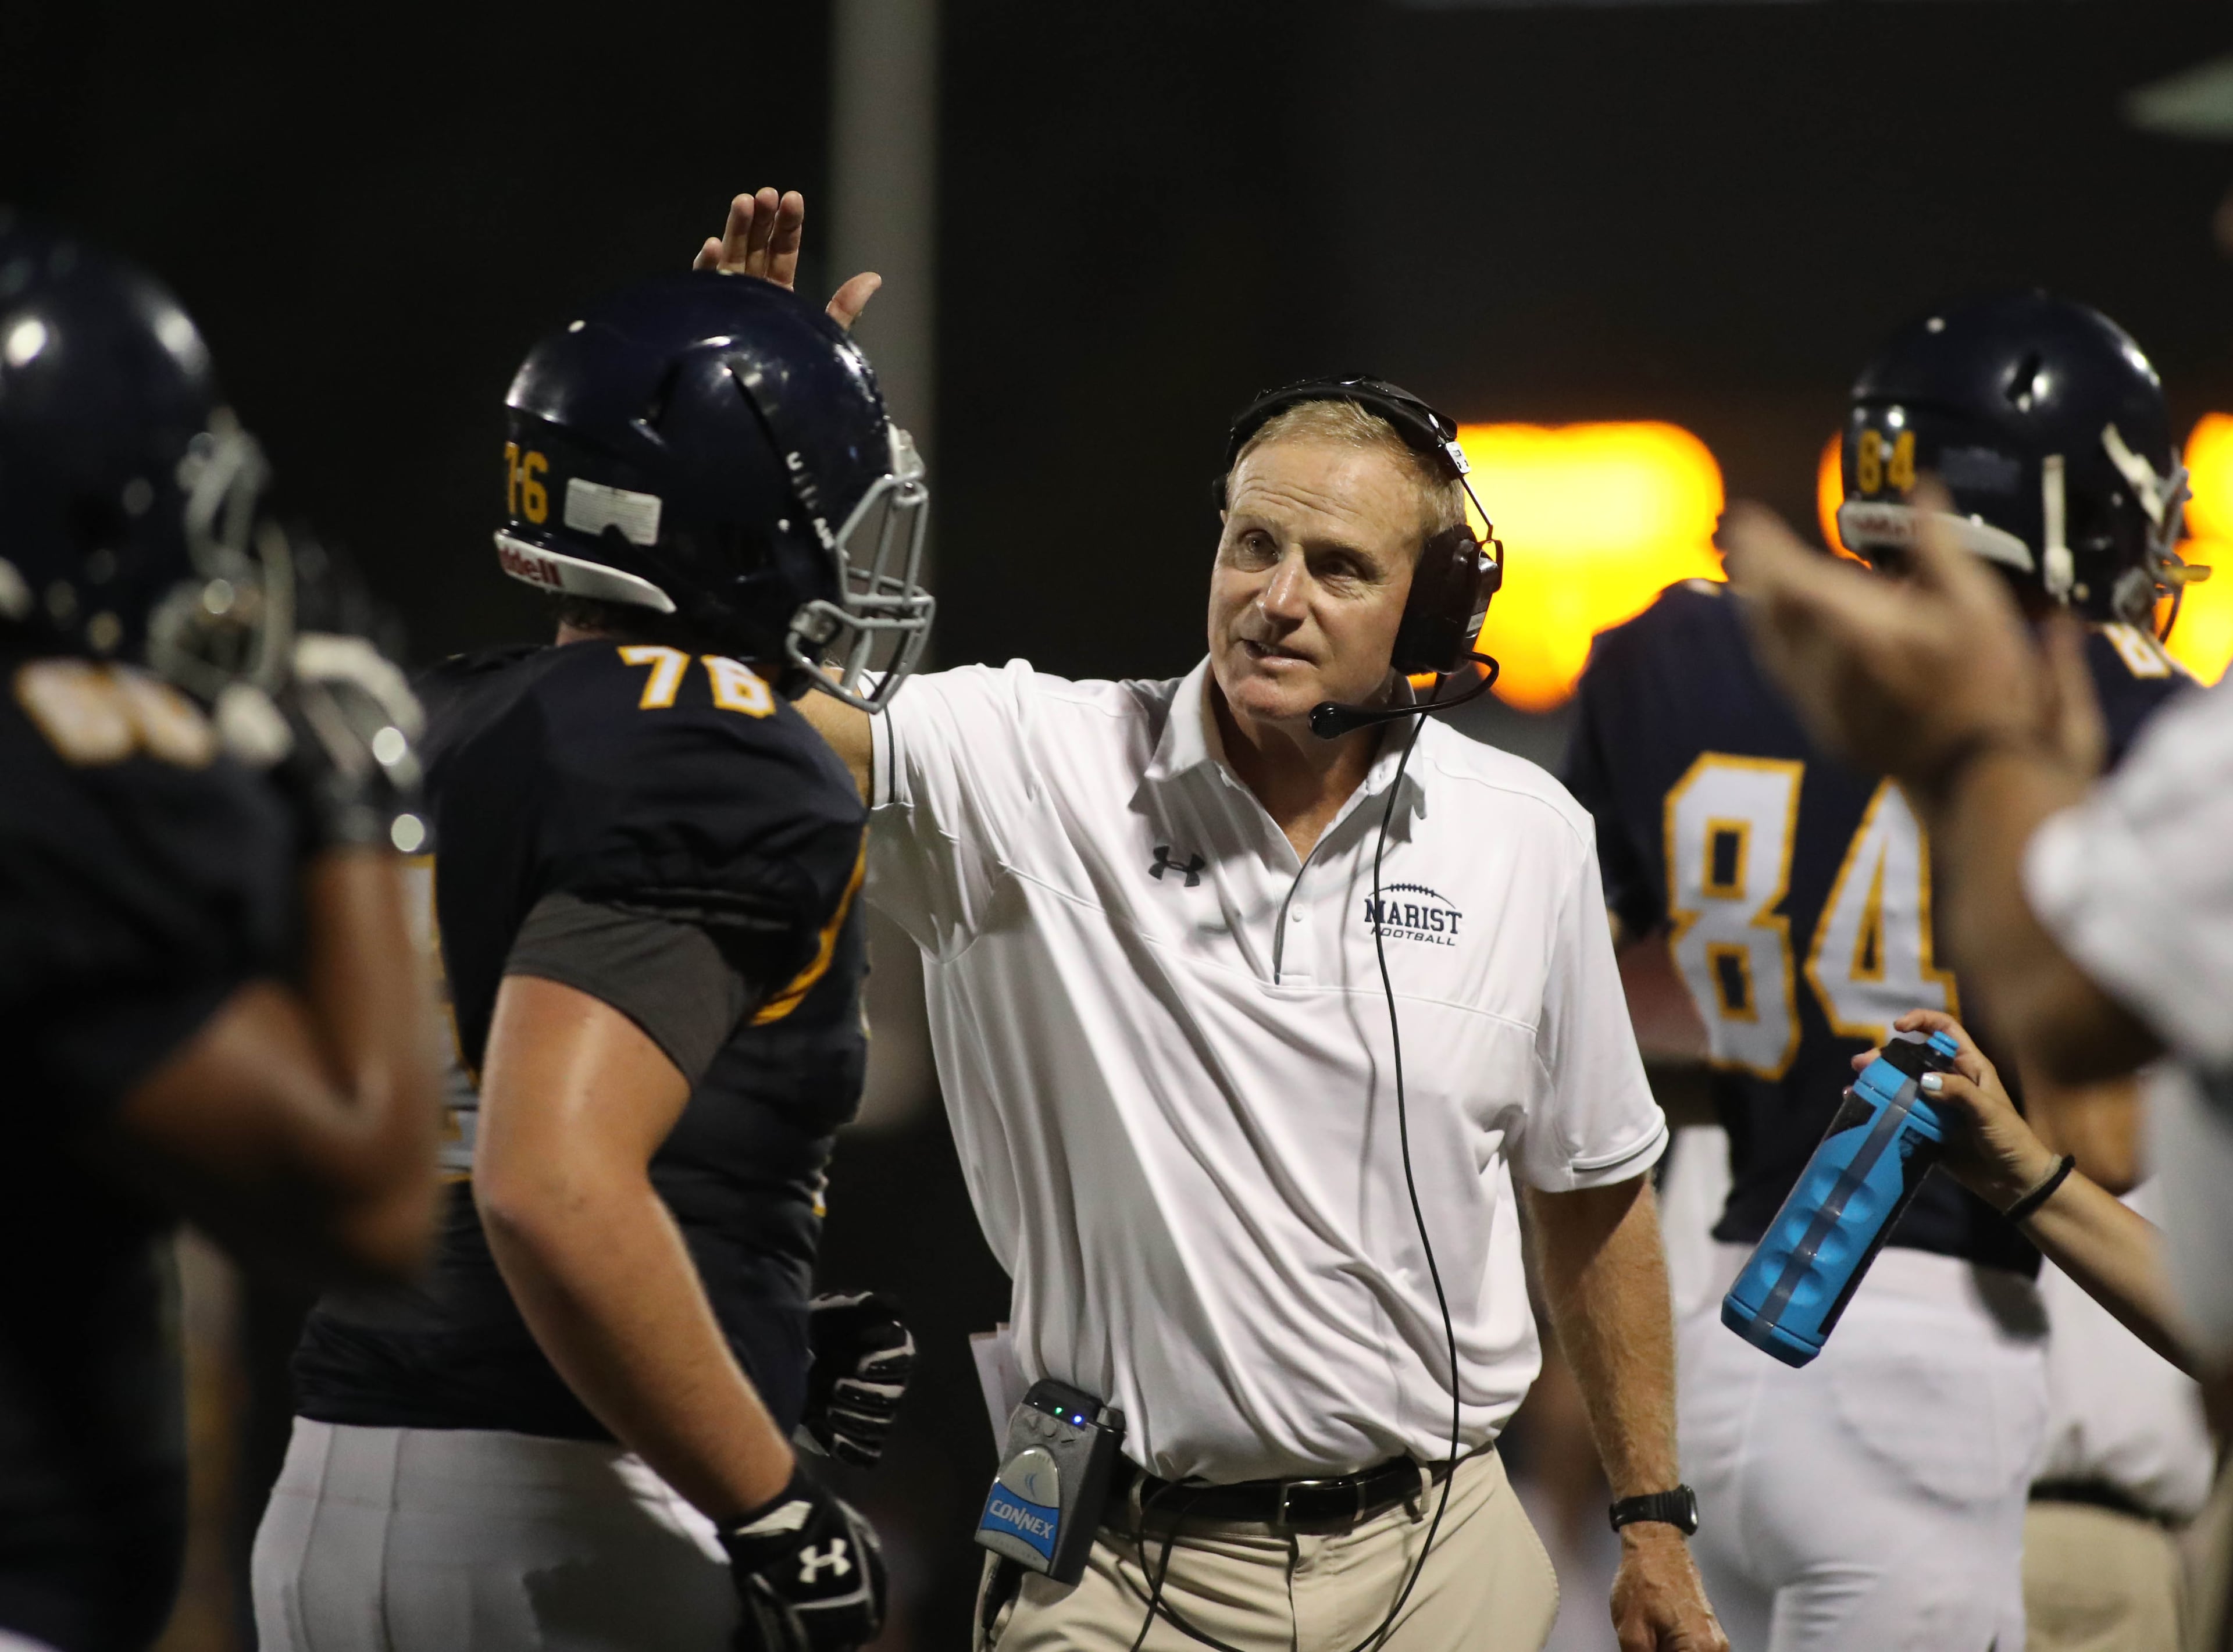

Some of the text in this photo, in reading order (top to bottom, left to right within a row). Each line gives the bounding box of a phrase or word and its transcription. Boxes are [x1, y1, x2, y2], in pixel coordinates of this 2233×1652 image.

[618, 644, 776, 719] 76
[1364, 898, 1462, 934] MARIST
[1663, 751, 1962, 1081] 84
[990, 1499, 1054, 1539] CONNEX
